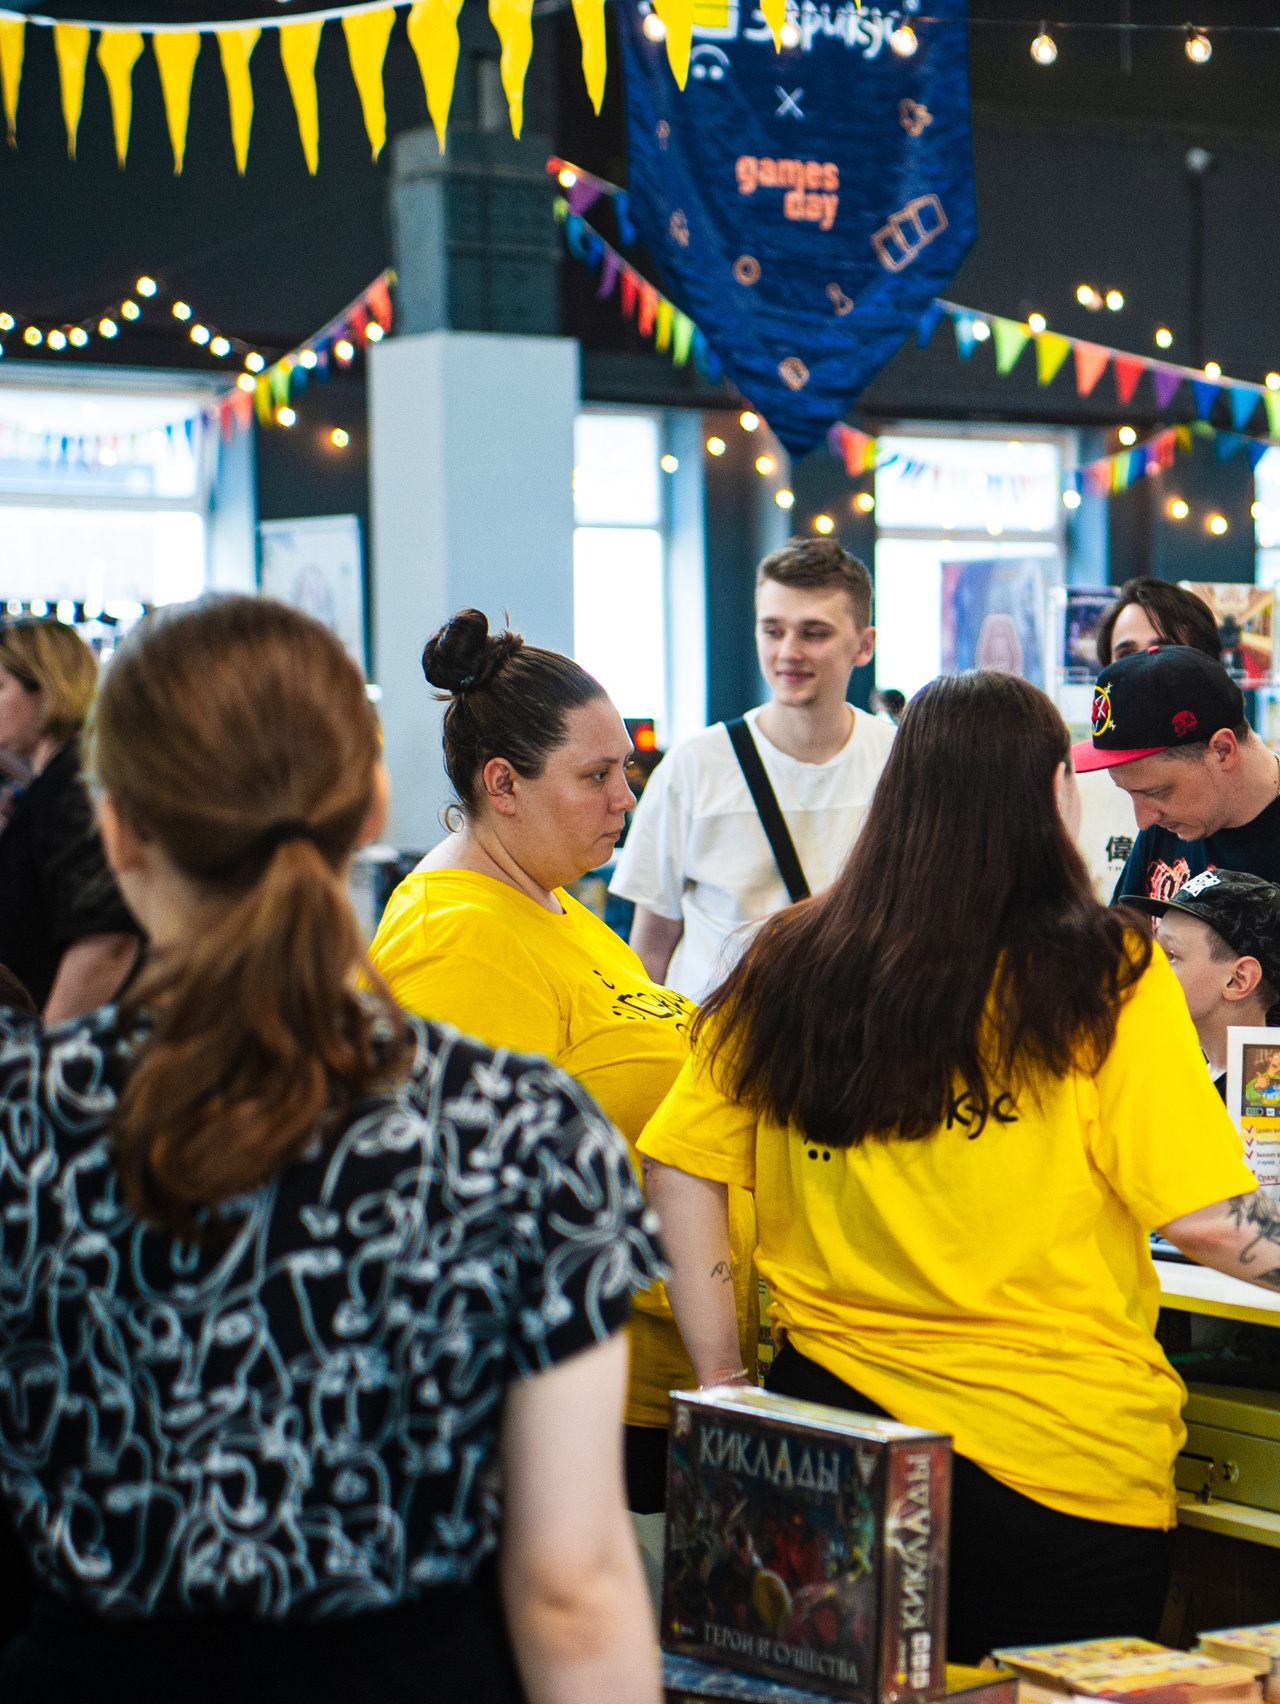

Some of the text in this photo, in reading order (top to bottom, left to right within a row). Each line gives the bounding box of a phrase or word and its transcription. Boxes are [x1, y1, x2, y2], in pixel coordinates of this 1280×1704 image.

[736, 155, 839, 195] games
[783, 187, 839, 231] day
[699, 1424, 841, 1495] КИКЛАДЫ
[703, 1620, 753, 1656] ГЕРОИ
